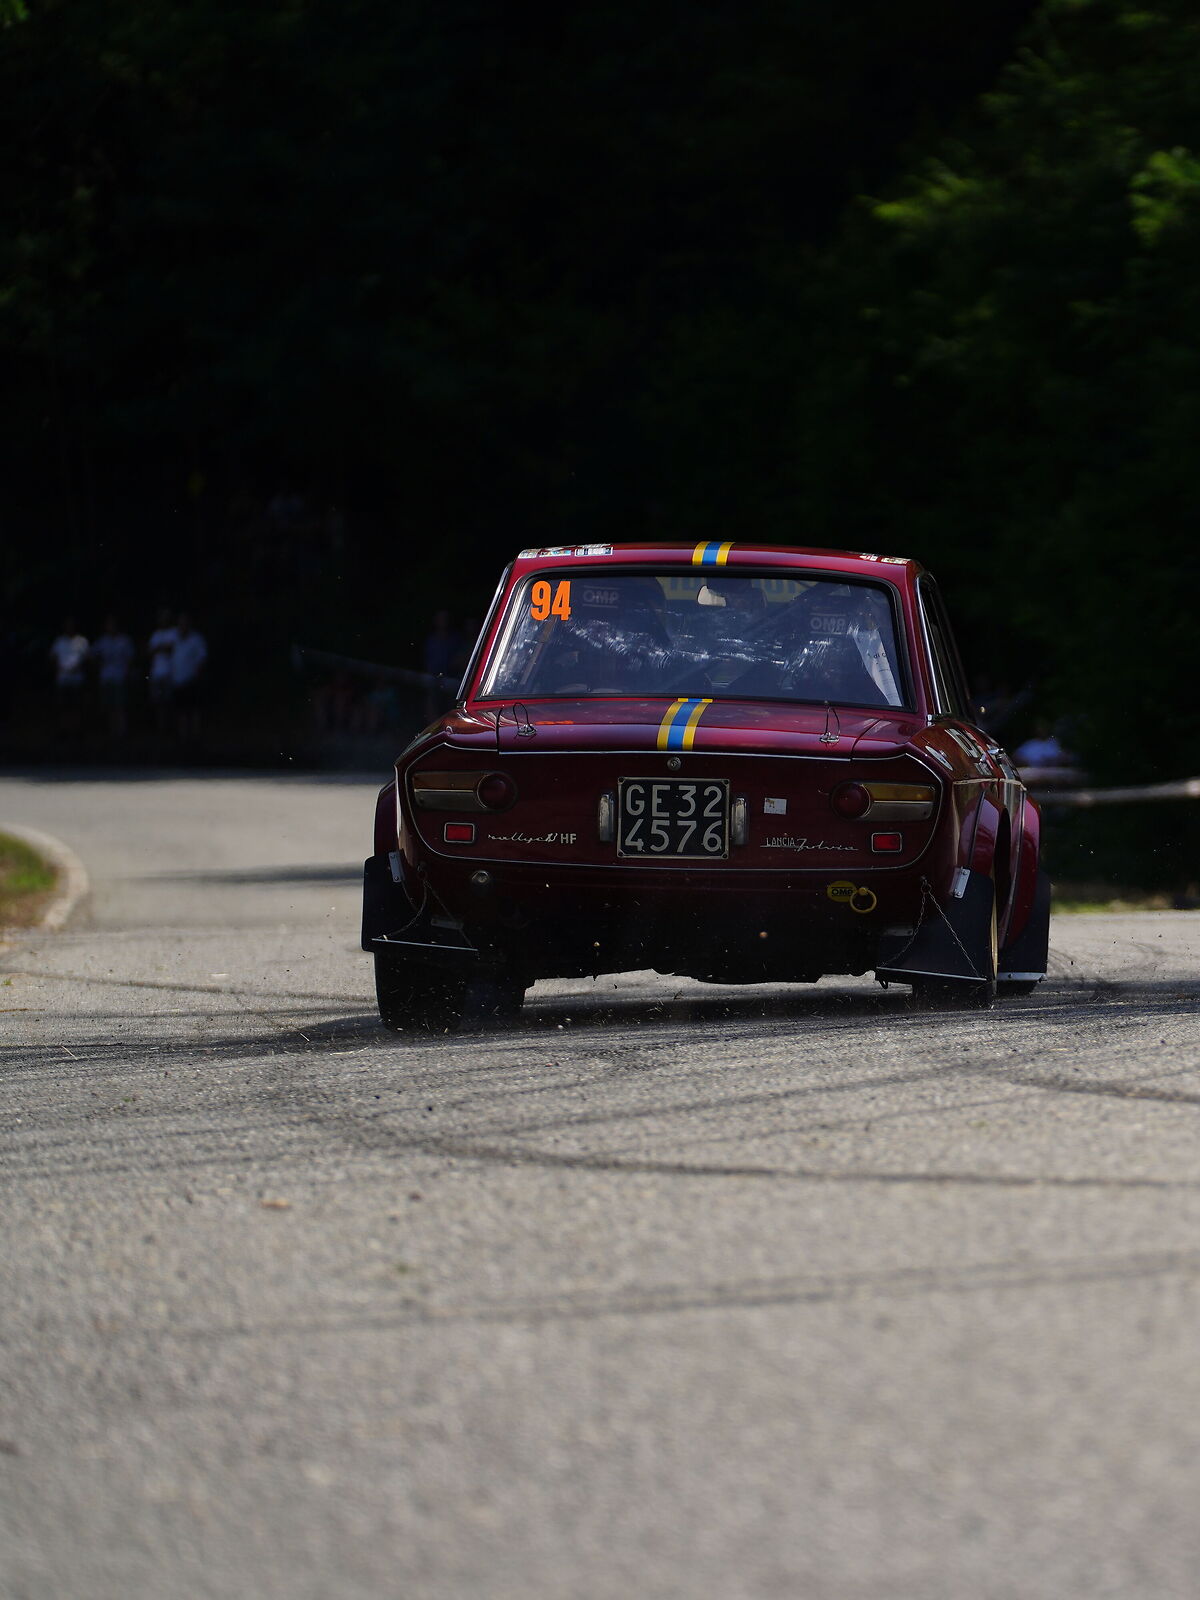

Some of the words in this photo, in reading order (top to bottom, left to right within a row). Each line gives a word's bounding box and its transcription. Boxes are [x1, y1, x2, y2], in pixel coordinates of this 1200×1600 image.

[530, 580, 572, 621] 94
[583, 589, 620, 604] OMP
[625, 784, 723, 818] GE32
[560, 832, 577, 845] HF
[624, 818, 723, 853] 4576
[765, 837, 796, 847] LANCIA
